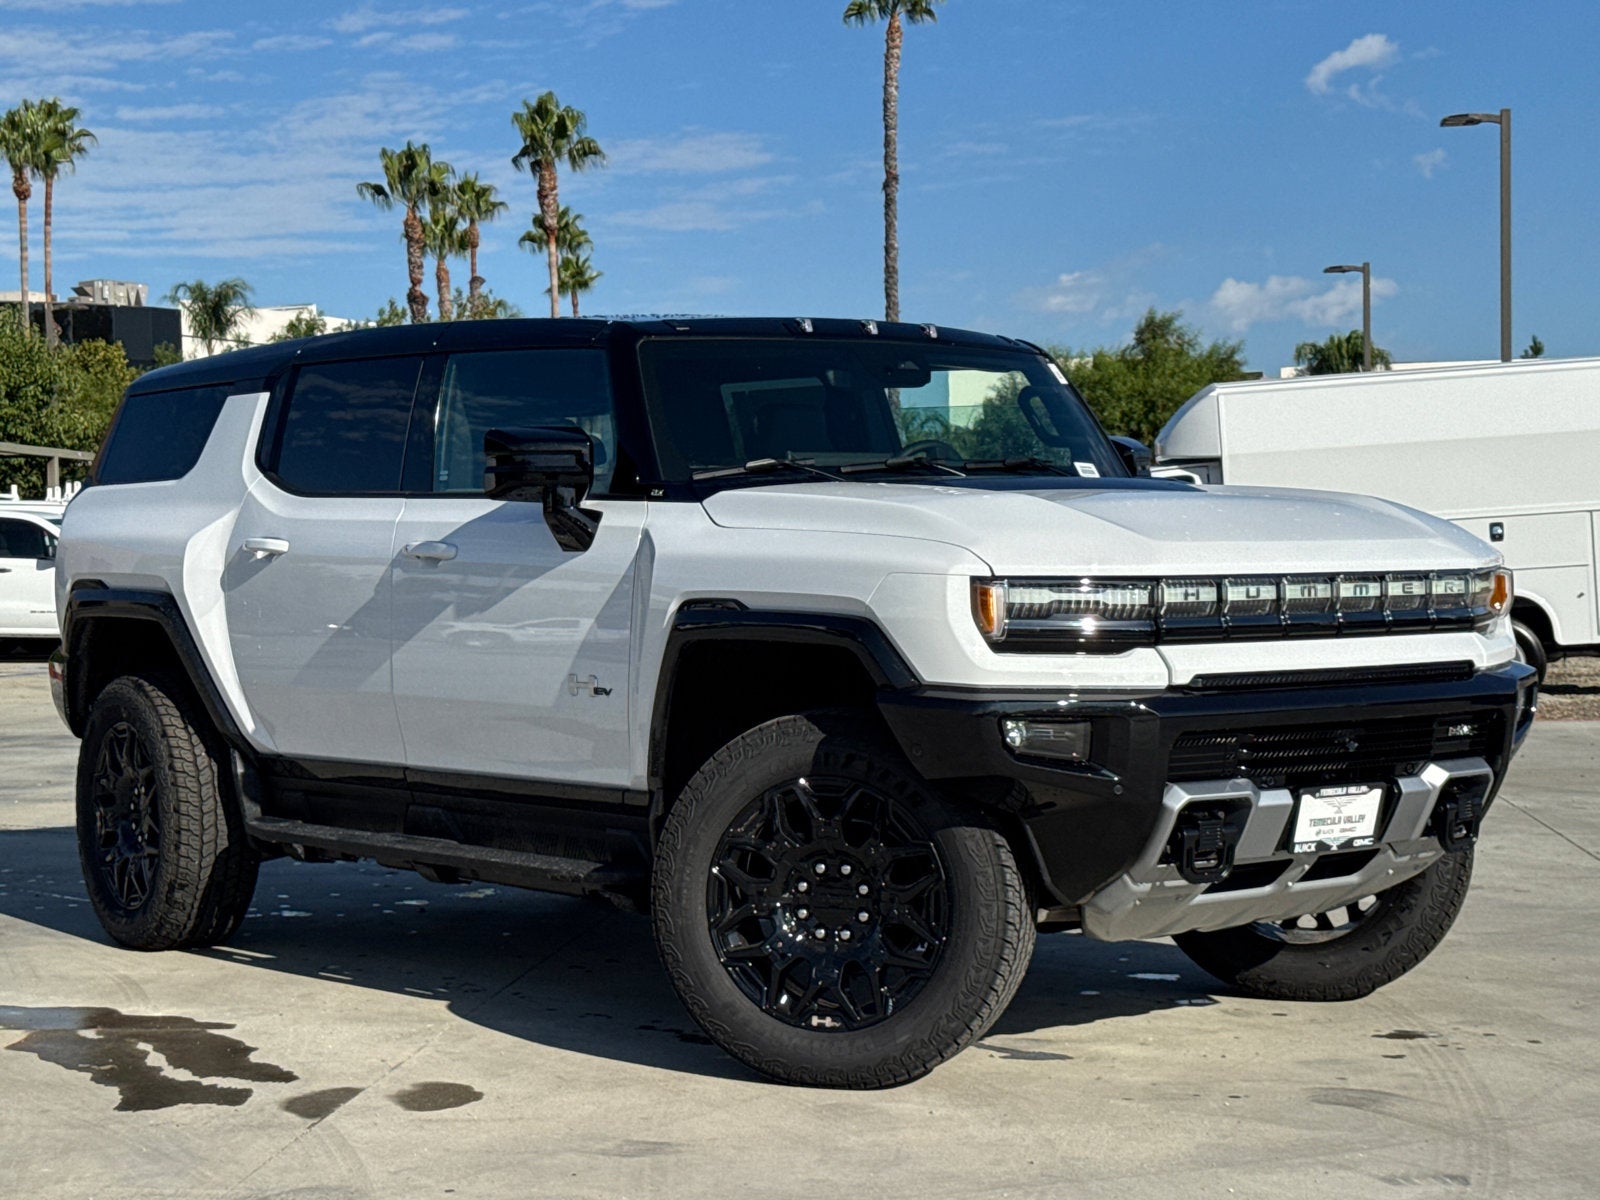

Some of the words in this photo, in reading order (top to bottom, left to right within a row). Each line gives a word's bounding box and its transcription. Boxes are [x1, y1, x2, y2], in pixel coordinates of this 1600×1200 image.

[1183, 580, 1456, 601] HUMMER
[593, 686, 613, 697] EV
[1343, 814, 1366, 824] VALLEY
[1294, 842, 1317, 853] BUICK
[1353, 838, 1375, 847] GMC
